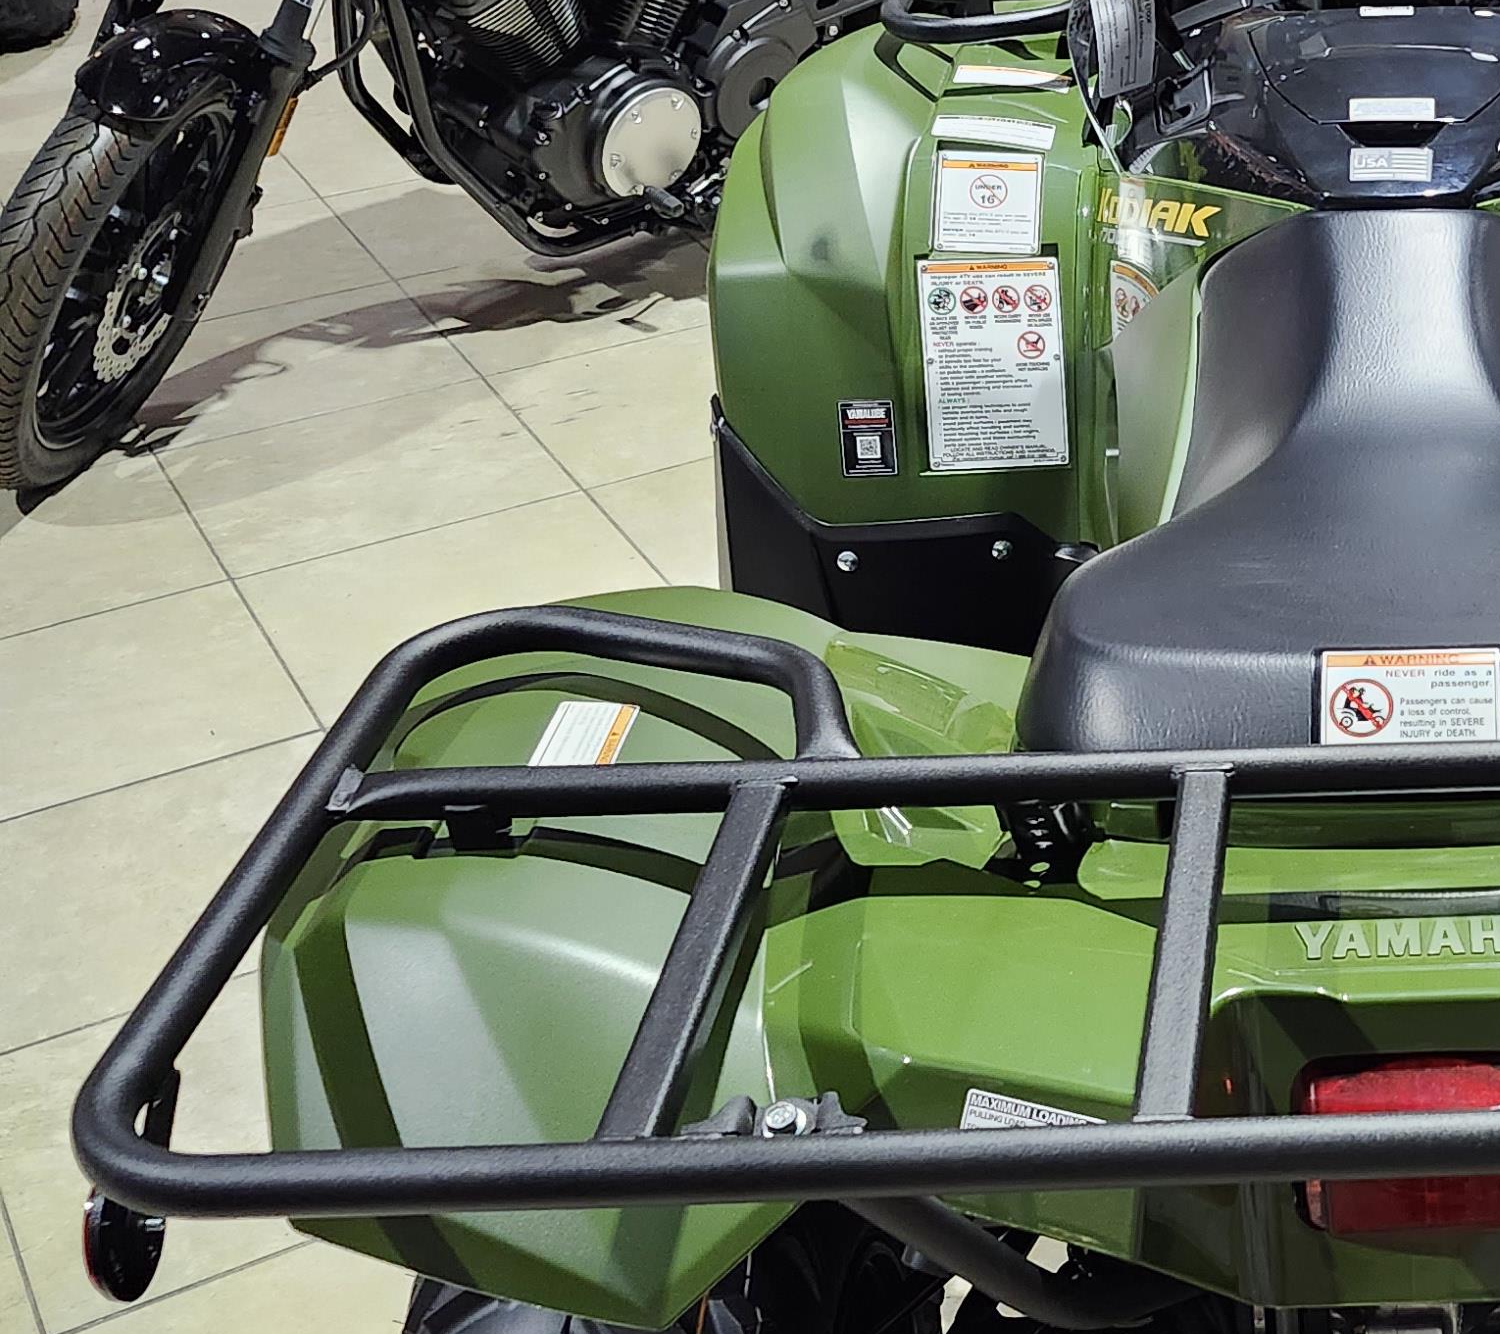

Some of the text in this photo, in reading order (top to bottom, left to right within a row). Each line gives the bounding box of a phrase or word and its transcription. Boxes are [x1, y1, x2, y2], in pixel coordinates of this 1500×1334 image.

[1354, 156, 1388, 168] USA
[981, 195, 995, 204] 16
[1096, 187, 1223, 238] KODIAK
[846, 407, 887, 419] YAMALUBE
[1380, 655, 1459, 665] WARNING
[1385, 670, 1425, 678] NEVER
[1431, 680, 1492, 689] passenger.
[1400, 698, 1447, 706] Passengers
[1408, 708, 1425, 716] loss
[1400, 719, 1435, 728] resulting
[1451, 718, 1485, 726] SEVERE
[1400, 729, 1476, 738] INJURY or DEATH.
[970, 1092, 1032, 1120] MAXIMUM
[969, 1108, 1003, 1124] PULLING
